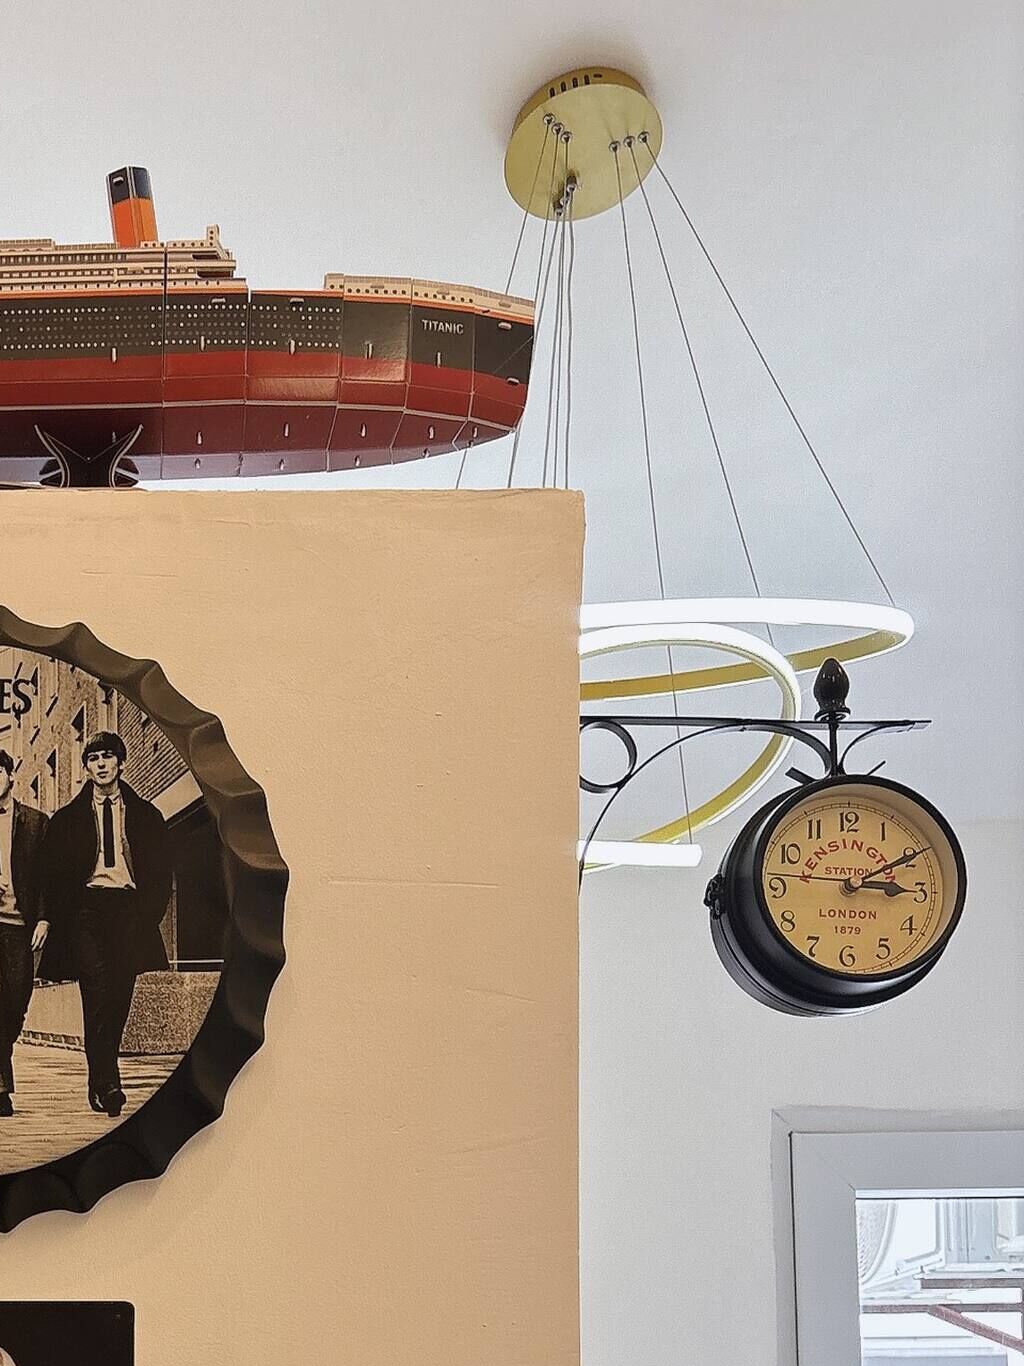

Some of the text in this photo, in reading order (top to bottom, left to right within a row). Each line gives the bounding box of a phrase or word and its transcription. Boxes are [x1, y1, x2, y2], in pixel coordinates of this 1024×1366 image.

[421, 319, 464, 335] TITANIC
[807, 819, 822, 841] 11
[838, 811, 860, 834] 12
[879, 821, 887, 842] 1
[780, 843, 802, 865] 10
[824, 865, 873, 877] STATION
[768, 876, 787, 899] 9
[913, 882, 928, 903] 3
[779, 909, 796, 933] 8
[818, 908, 878, 921] LONDON
[900, 914, 918, 936] 4
[833, 925, 862, 936] 1879
[806, 935, 821, 958] 7
[838, 945, 857, 968] 6
[875, 937, 891, 960] 5
